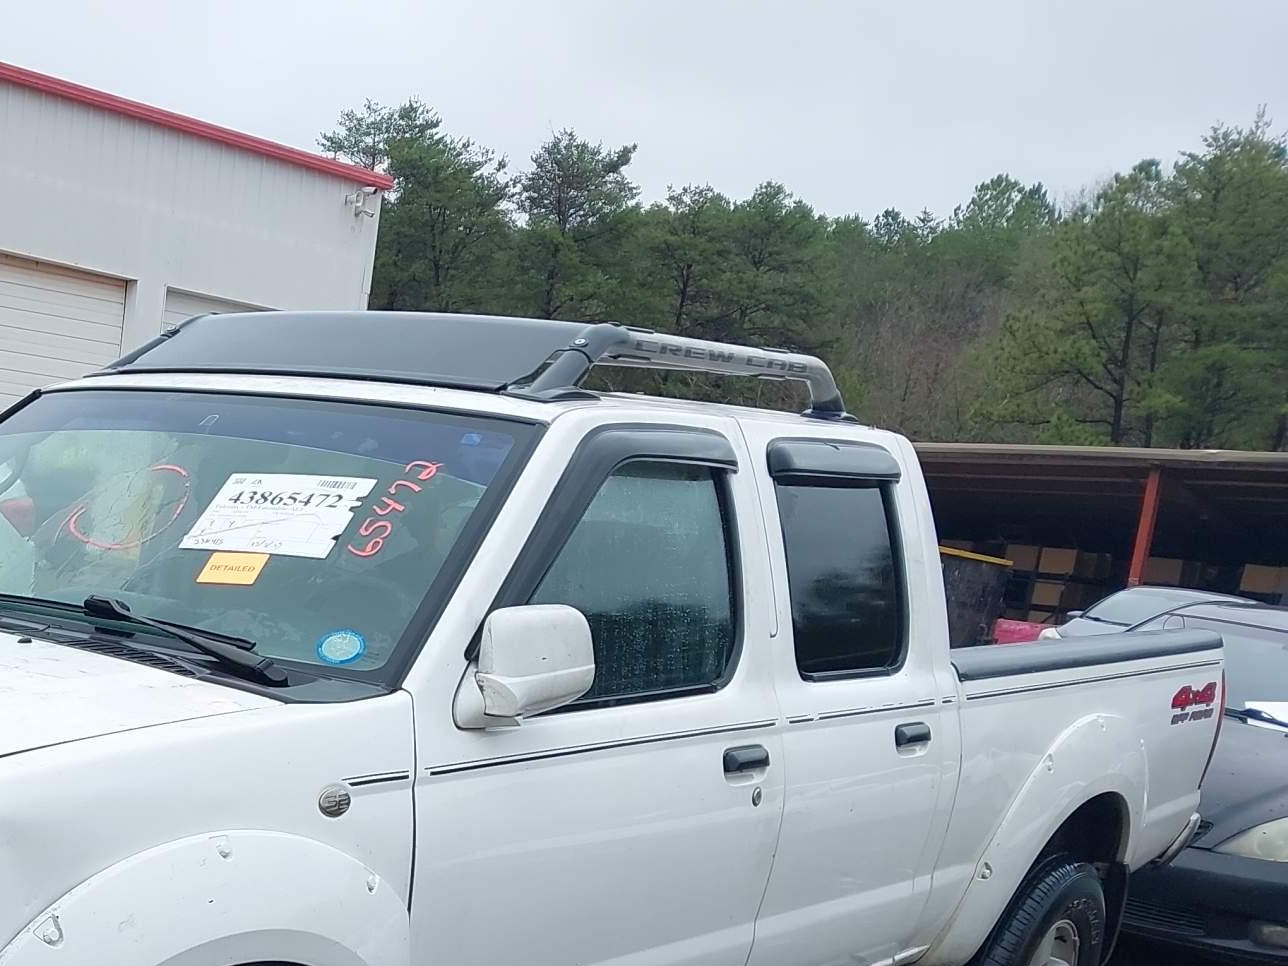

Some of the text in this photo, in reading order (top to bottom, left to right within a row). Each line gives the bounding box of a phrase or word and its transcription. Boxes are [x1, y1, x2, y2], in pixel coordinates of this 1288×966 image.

[634, 339, 809, 374] CREW CAB
[228, 490, 344, 509] 43865472
[346, 460, 445, 557] 65472
[209, 564, 256, 573] DETAILED
